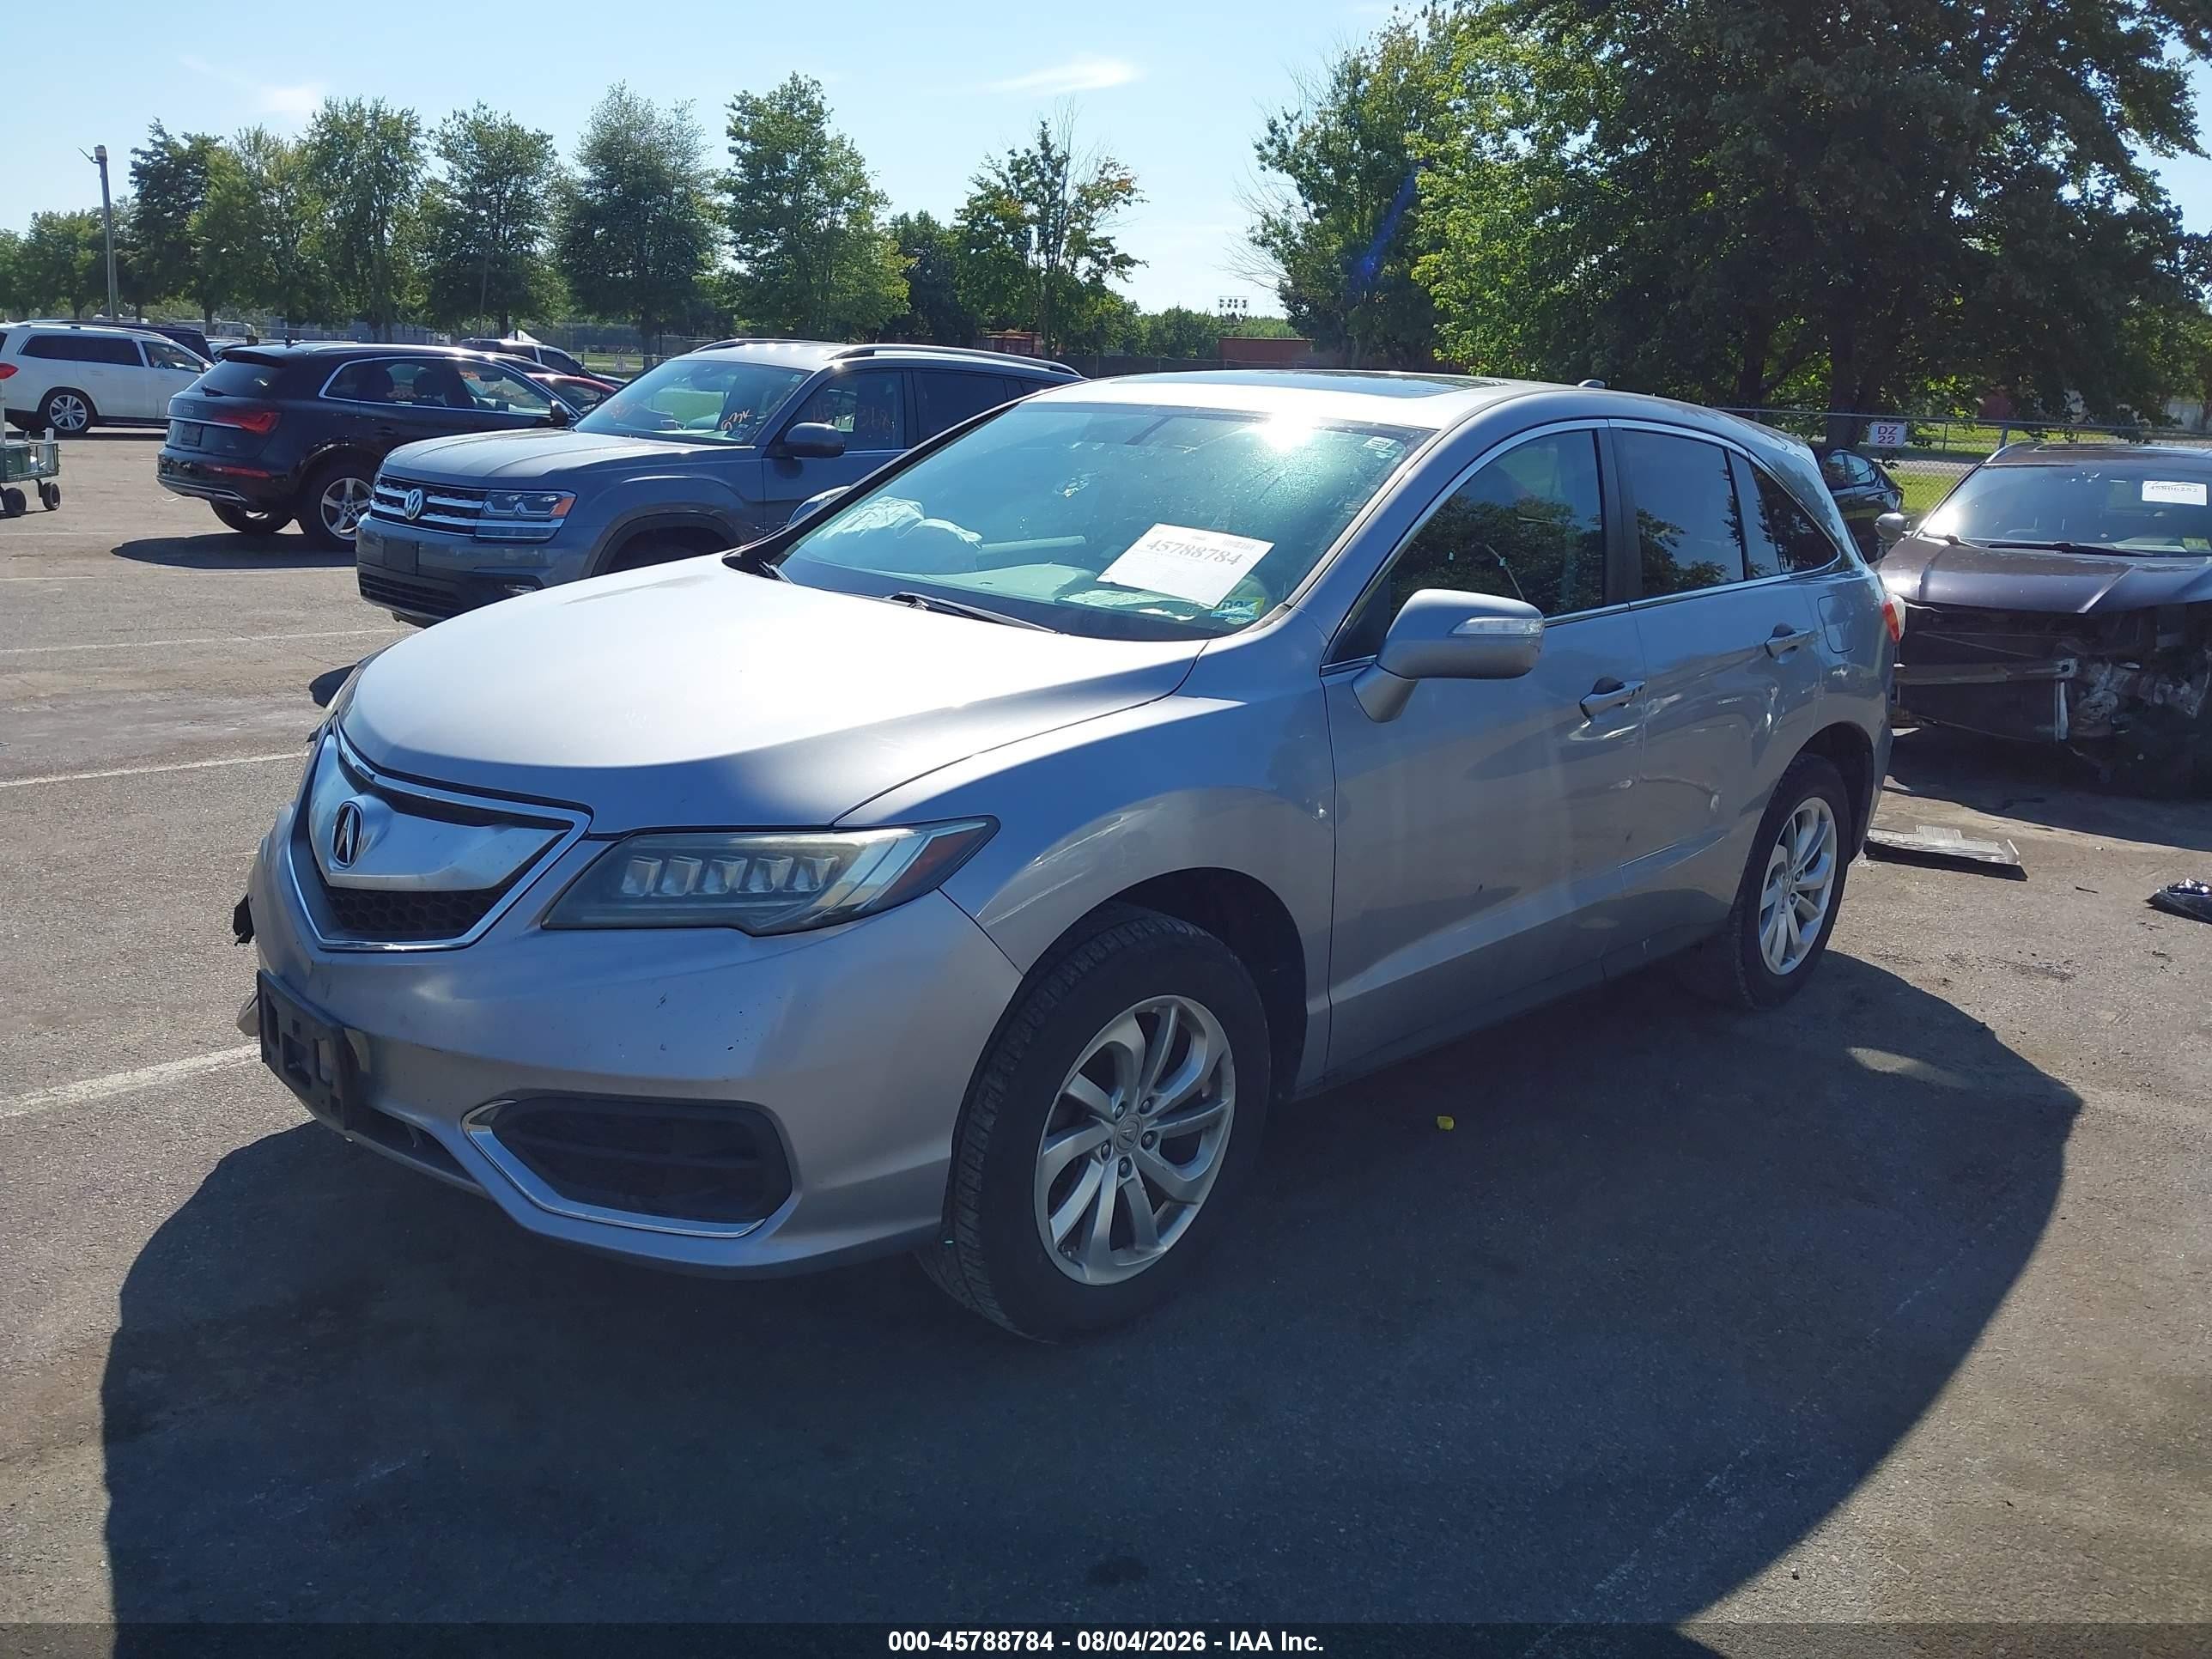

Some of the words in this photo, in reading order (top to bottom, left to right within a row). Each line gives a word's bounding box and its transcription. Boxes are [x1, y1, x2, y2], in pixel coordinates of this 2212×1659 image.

[1877, 425, 1897, 435] DZ
[1877, 435, 1896, 444] 22
[1146, 538, 1243, 566] 45788784
